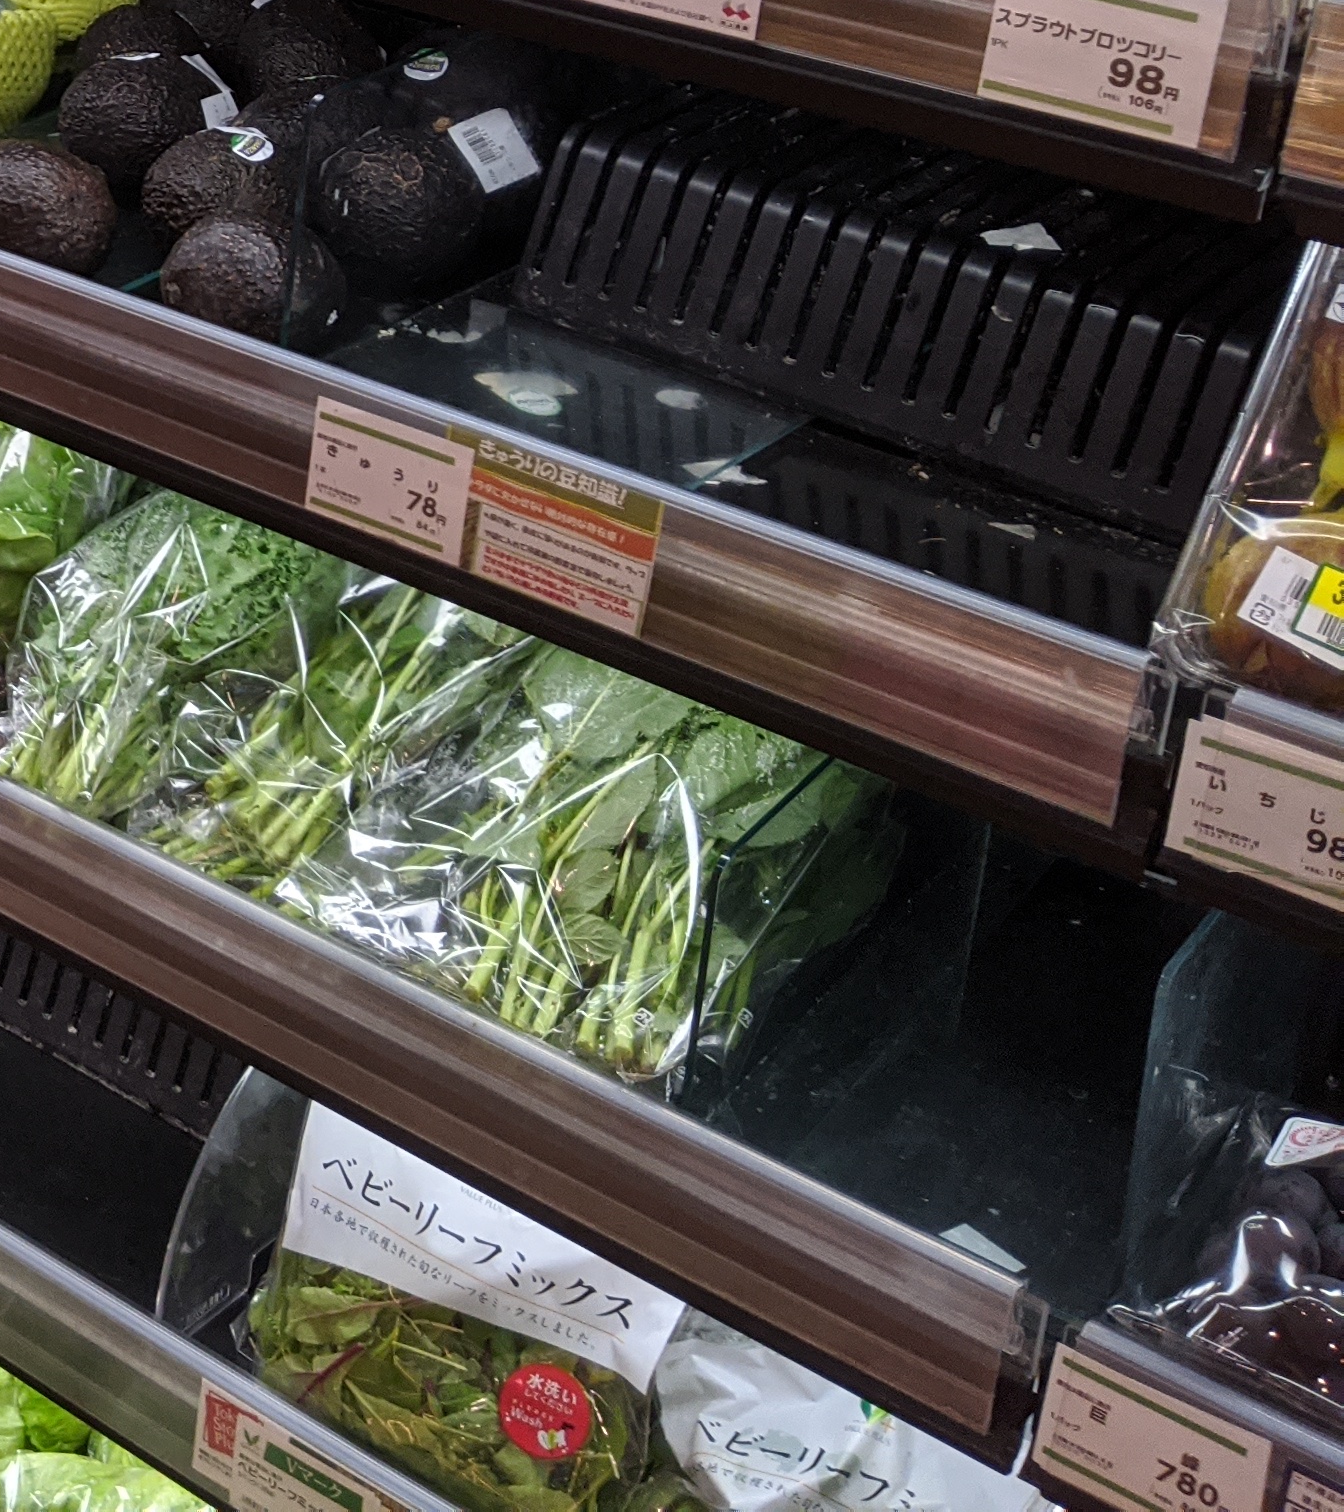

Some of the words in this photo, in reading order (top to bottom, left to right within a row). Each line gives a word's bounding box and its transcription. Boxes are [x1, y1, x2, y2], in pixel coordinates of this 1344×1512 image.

[1107, 57, 1179, 103] 98円
[324, 441, 440, 494] きゅうり
[405, 488, 447, 526] 78円
[321, 1156, 636, 1330] ベビーリーフミックス
[526, 1373, 578, 1405] 水洗い
[285, 1456, 342, 1499] Vマーク
